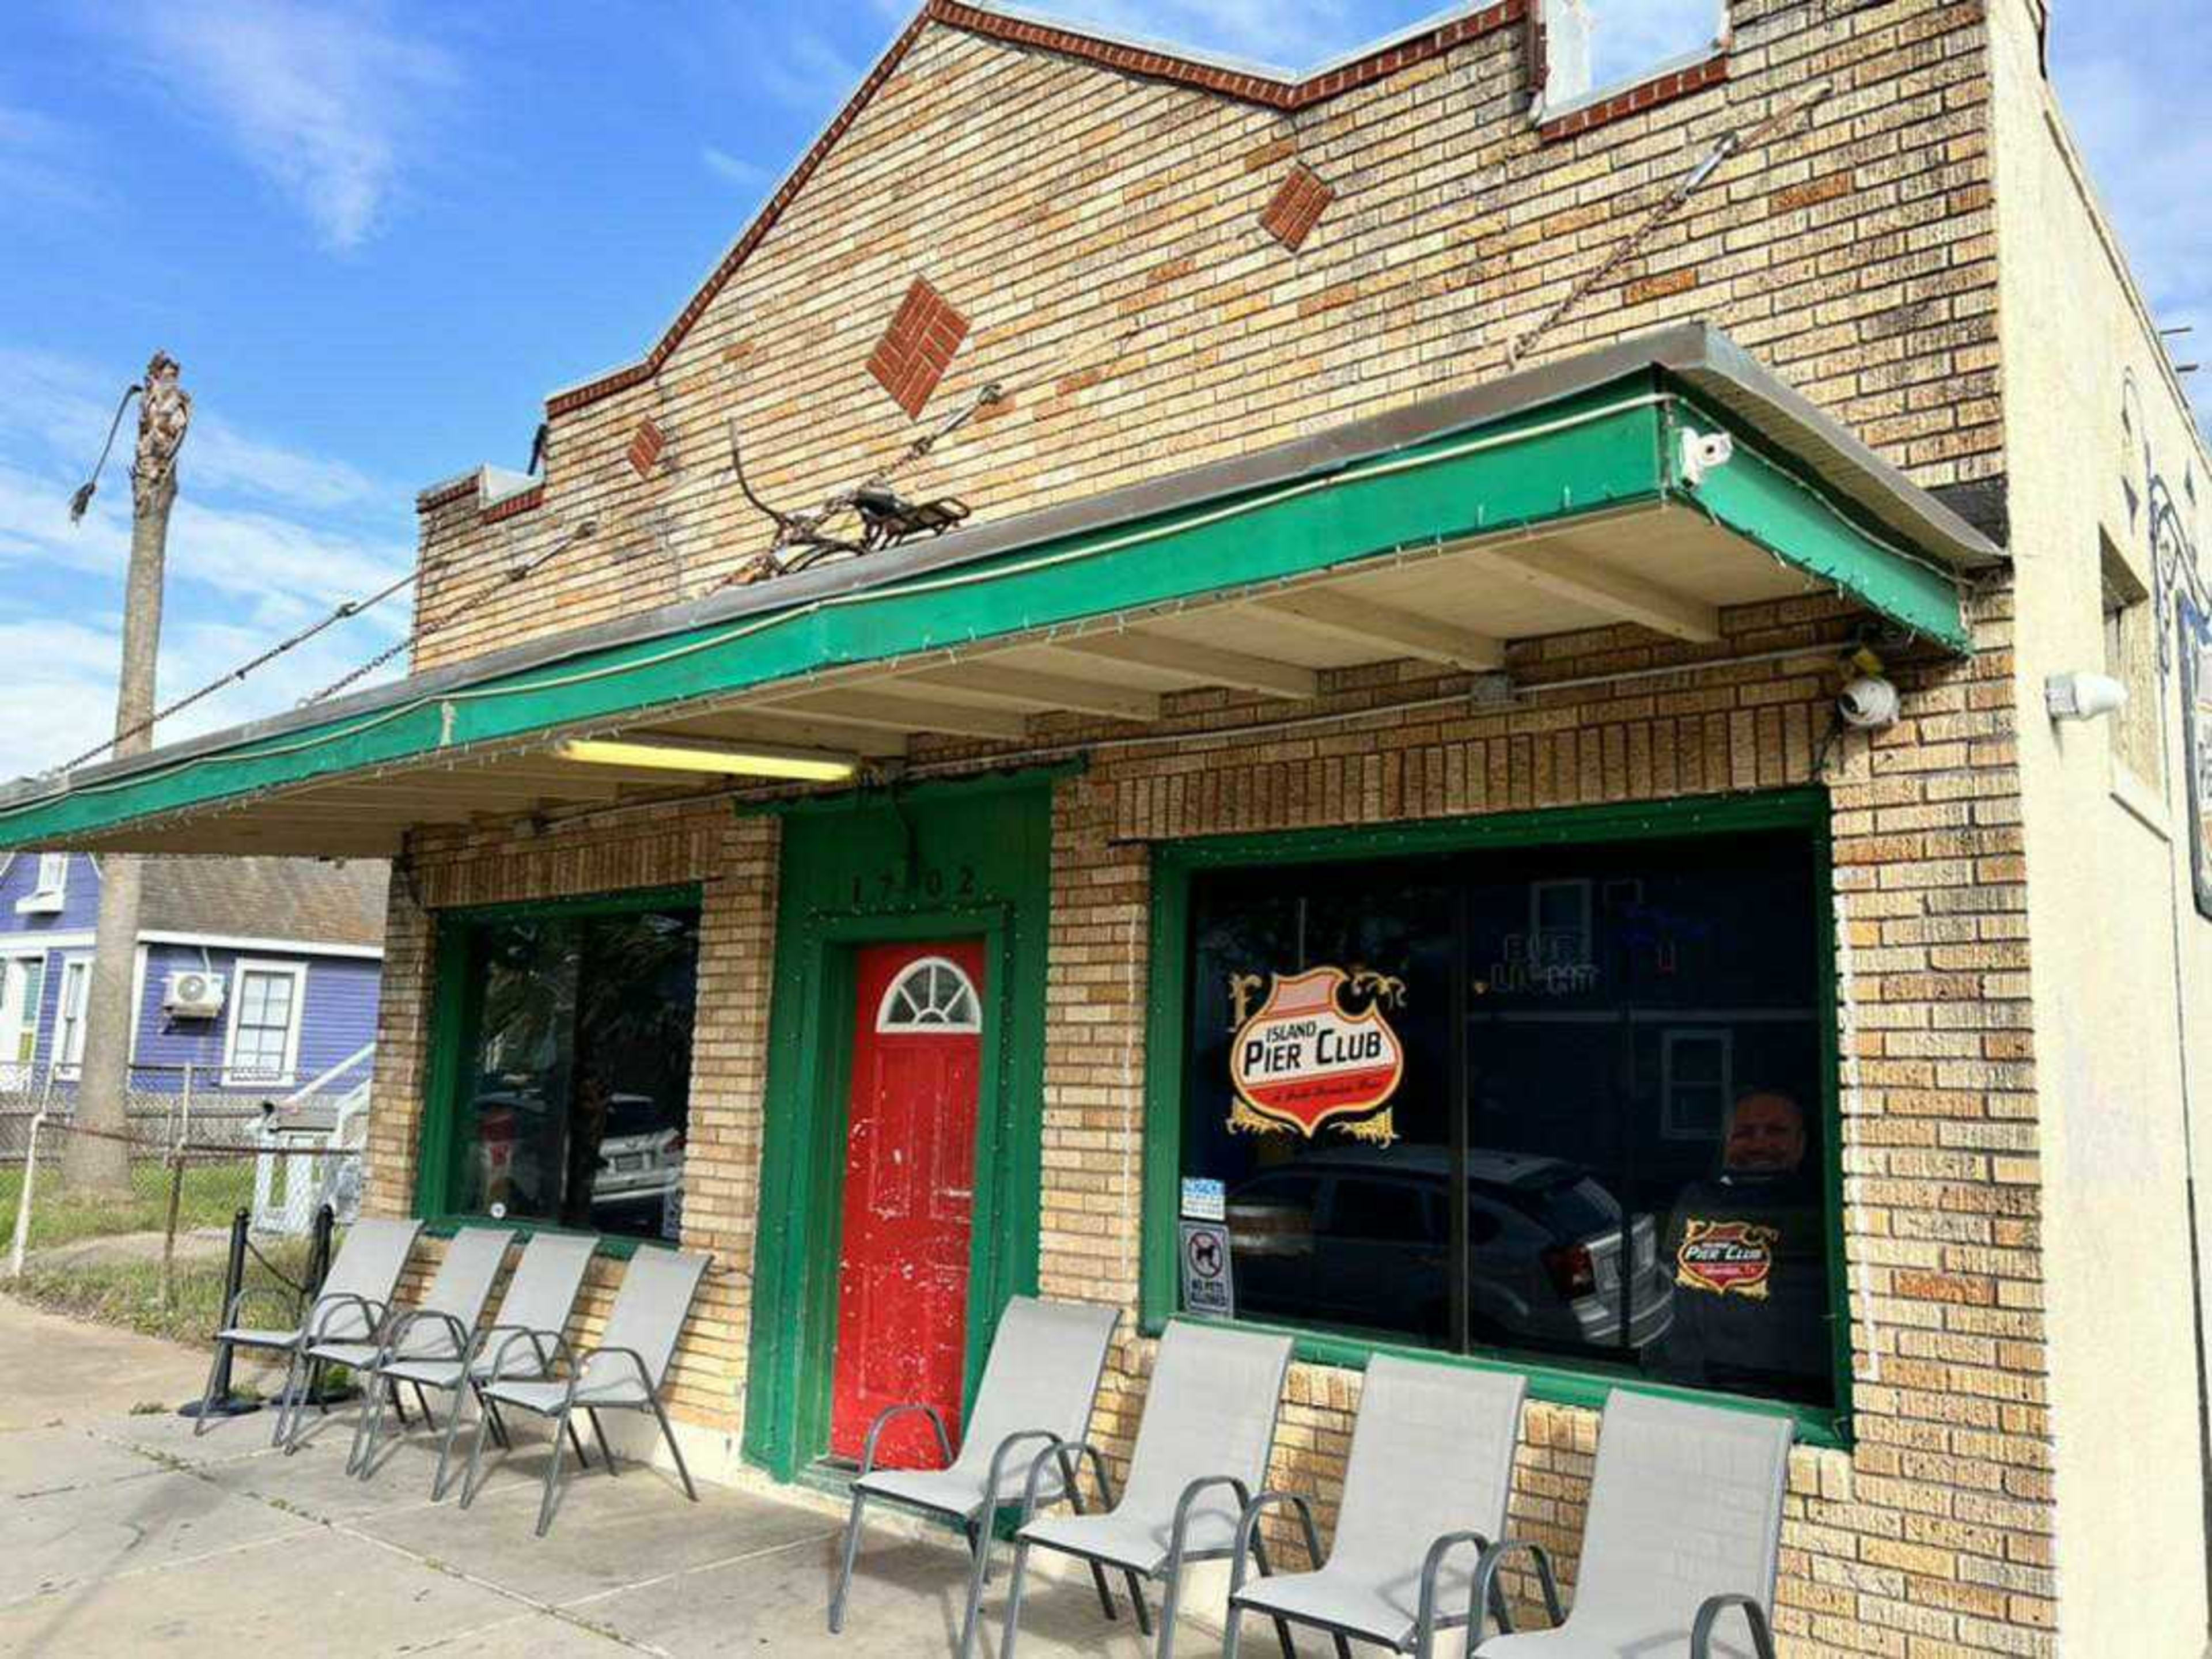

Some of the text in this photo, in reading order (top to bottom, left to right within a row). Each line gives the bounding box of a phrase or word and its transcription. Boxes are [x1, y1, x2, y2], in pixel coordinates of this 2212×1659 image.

[1266, 1021, 1317, 1043] ISLAND
[1243, 1029, 1382, 1077] PIER CLUB
